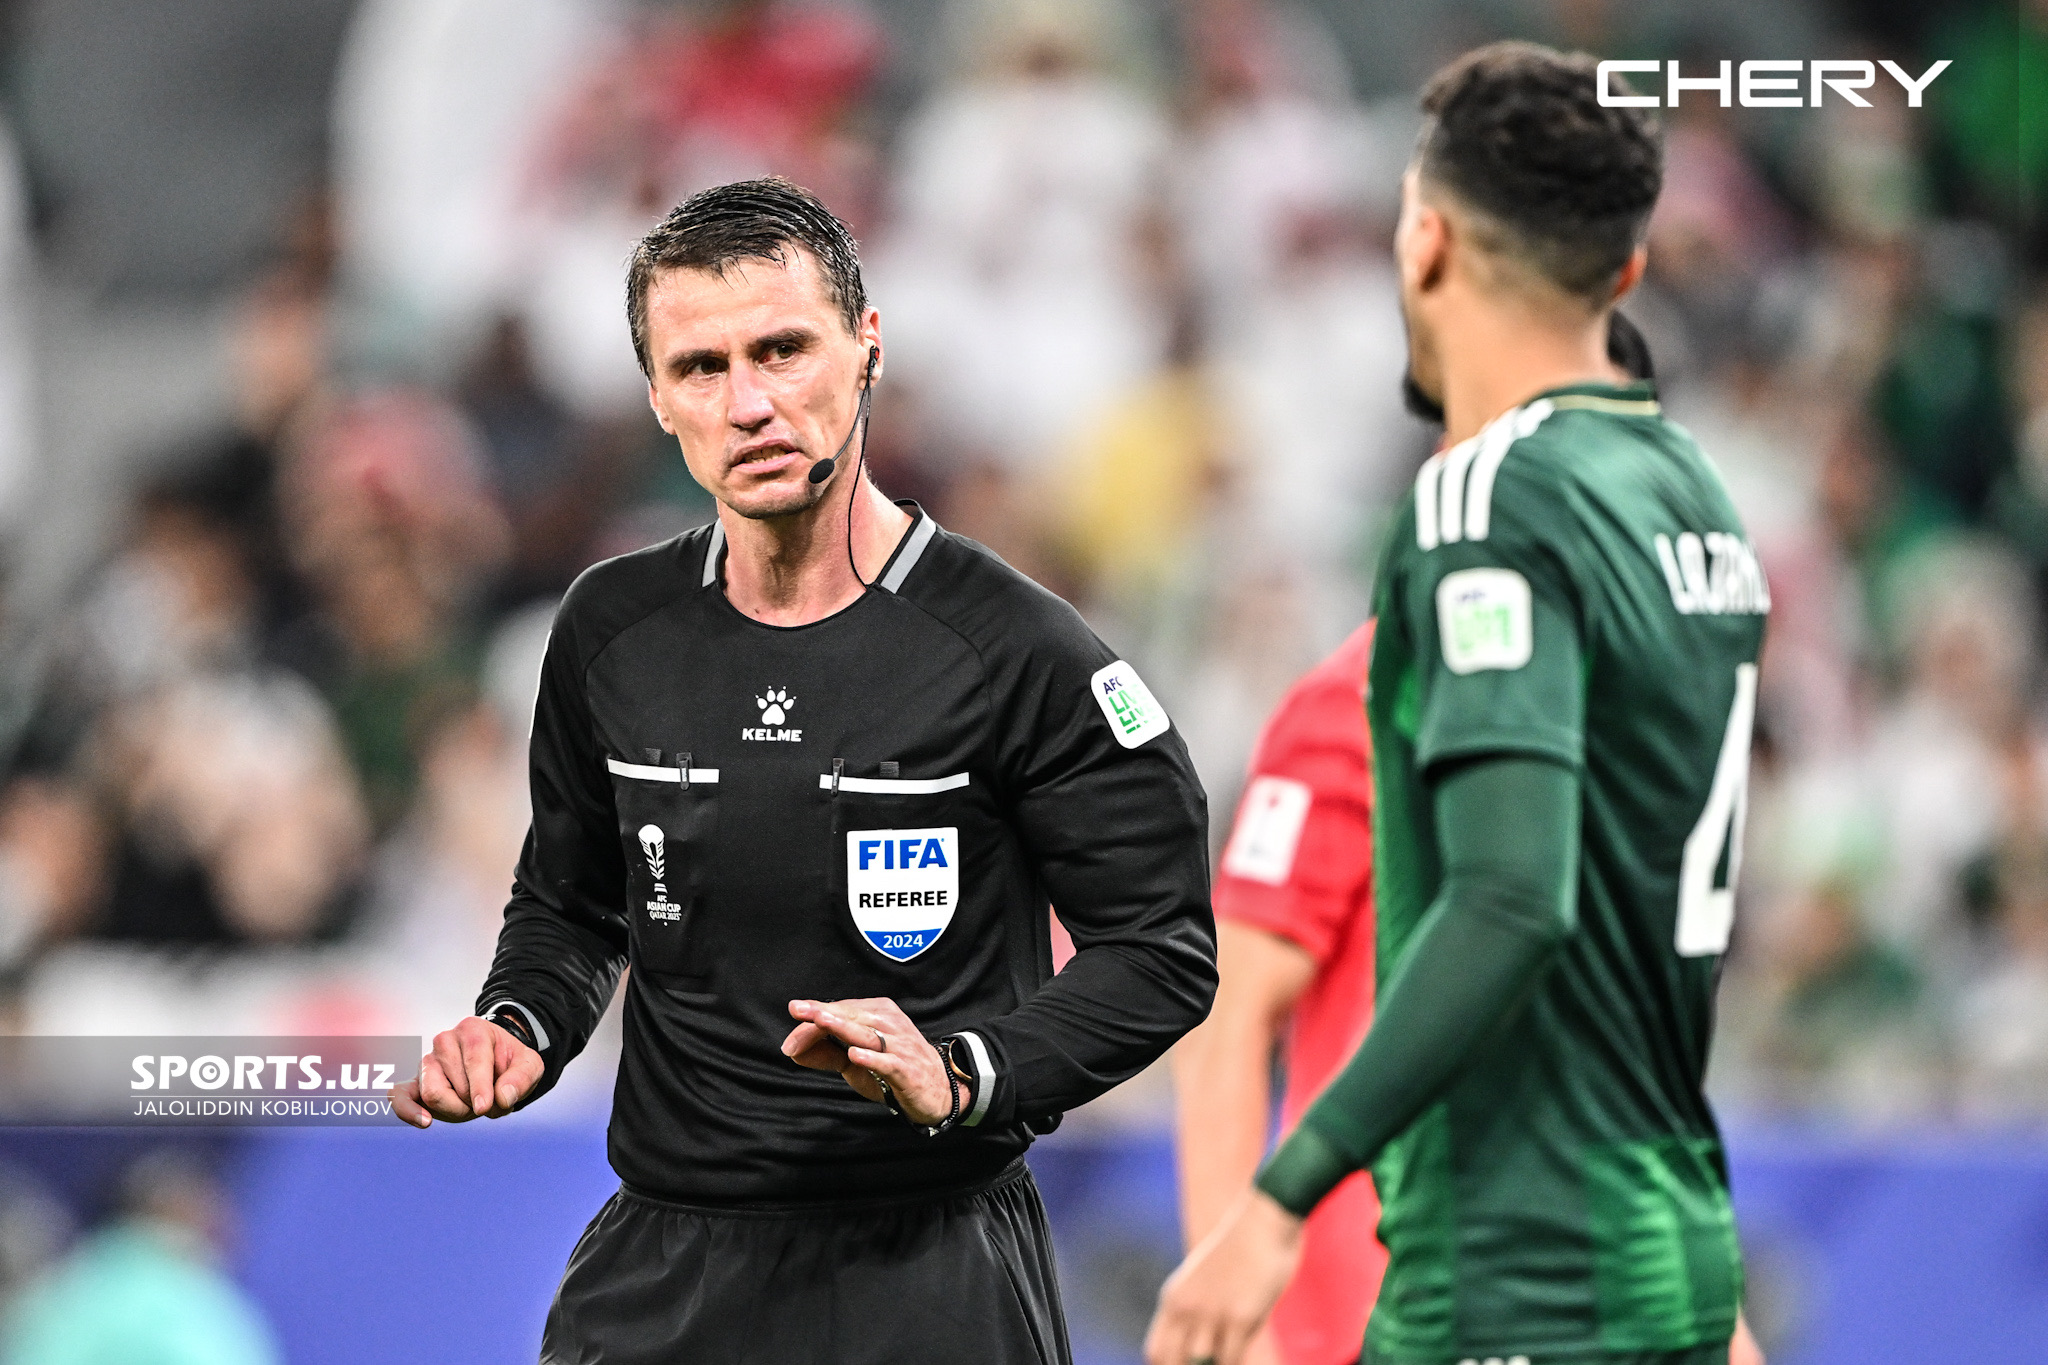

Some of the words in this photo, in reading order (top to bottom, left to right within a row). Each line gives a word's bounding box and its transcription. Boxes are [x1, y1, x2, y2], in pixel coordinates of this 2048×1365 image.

[742, 728, 802, 742] KELME
[1675, 663, 1758, 957] 4
[859, 838, 948, 870] FIFA
[647, 901, 667, 912] ASIAN
[667, 903, 681, 913] CUP
[859, 890, 948, 908] REFEREE
[883, 934, 924, 949] 2024
